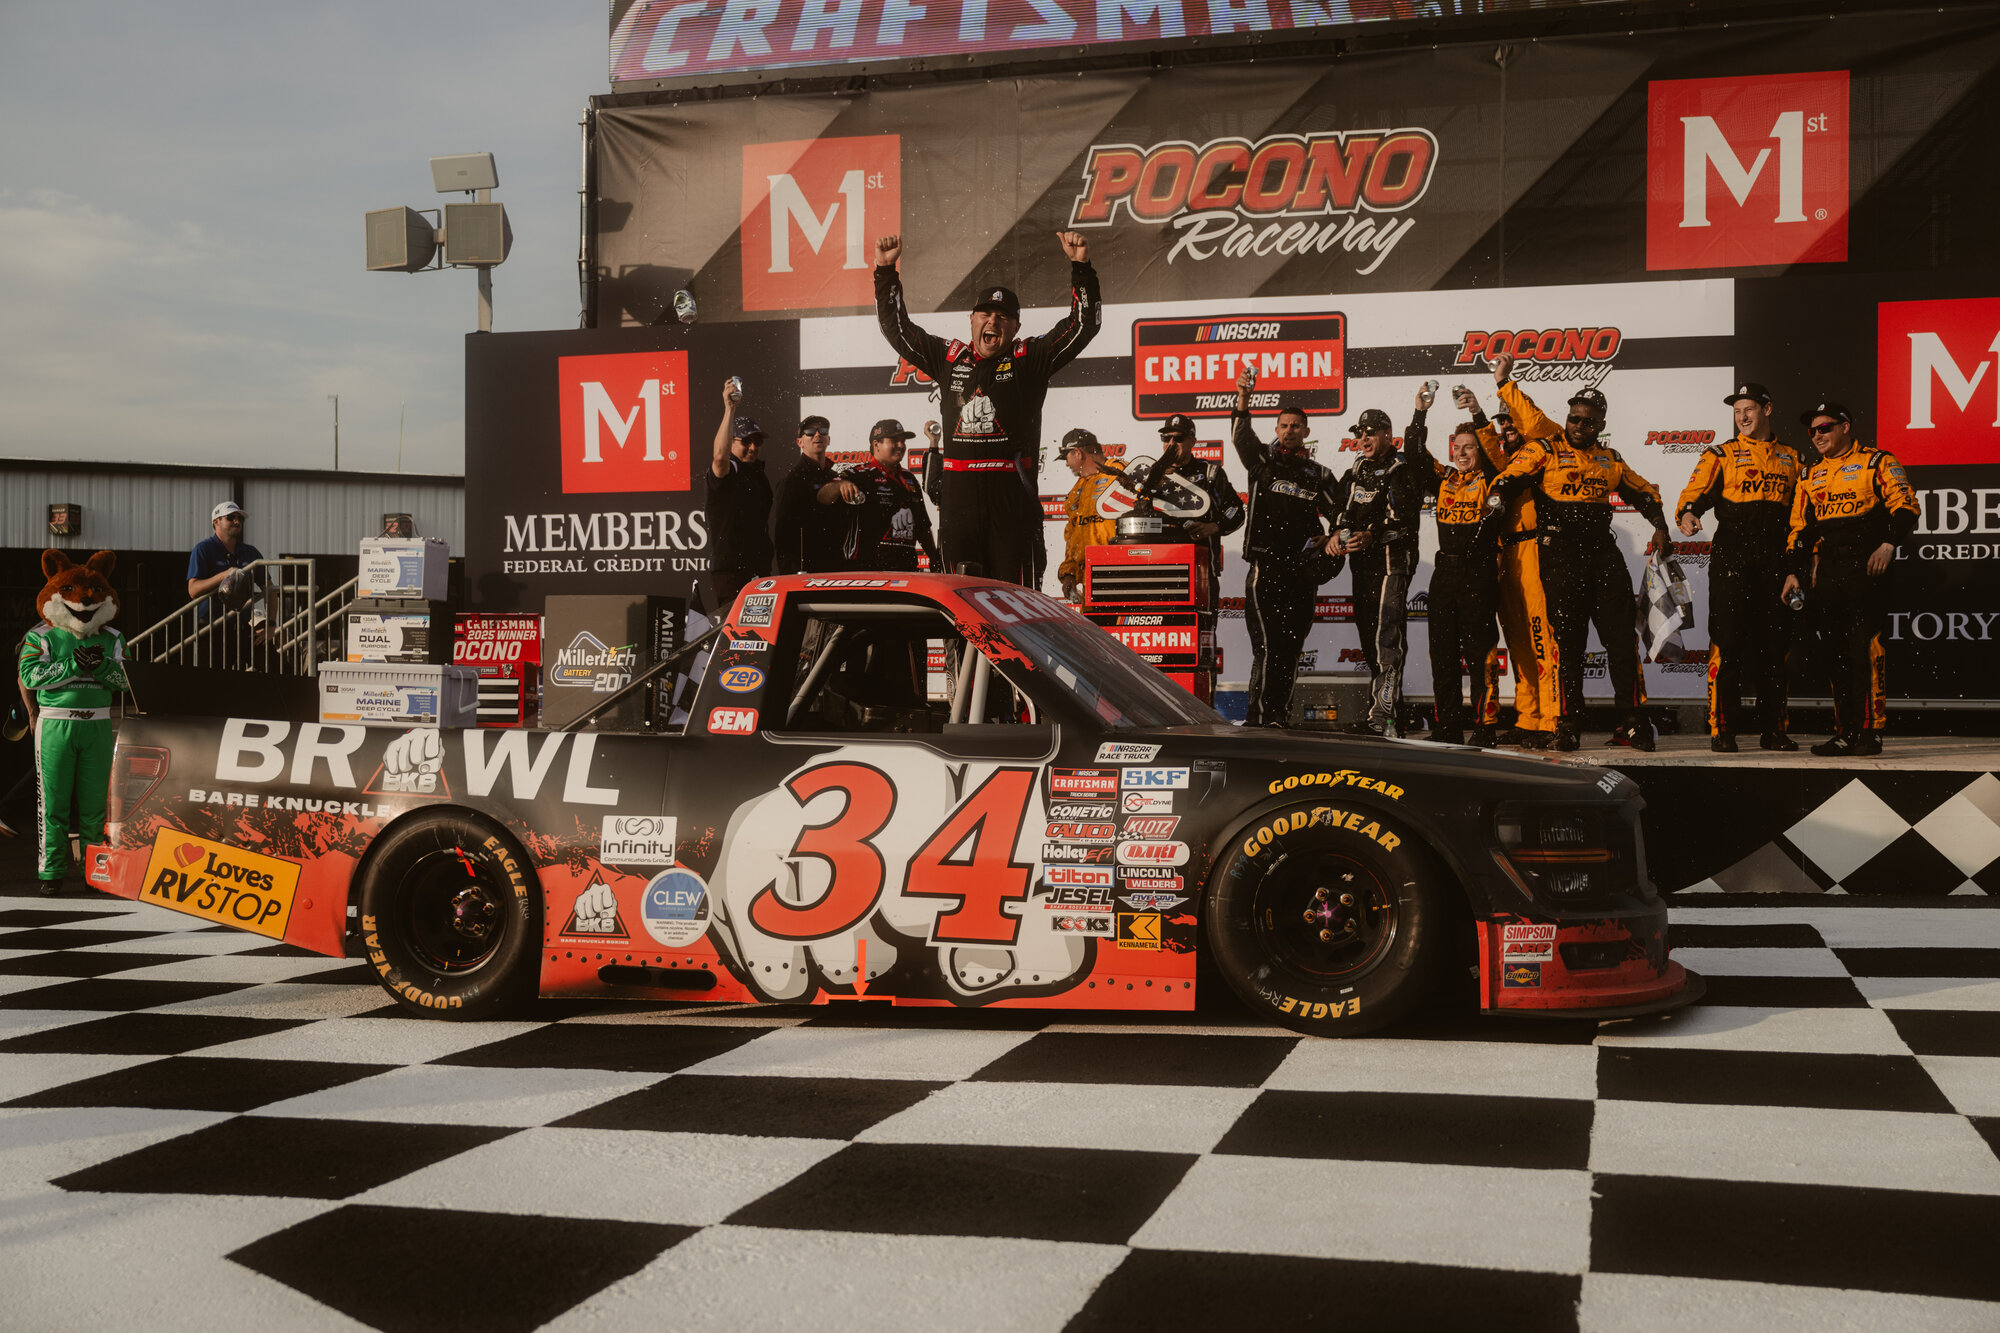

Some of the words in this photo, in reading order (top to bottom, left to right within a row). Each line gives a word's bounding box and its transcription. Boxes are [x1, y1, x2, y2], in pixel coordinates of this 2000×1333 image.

[1069, 127, 1440, 227] POCONO
[1165, 211, 1416, 275] Raceway
[1214, 322, 1281, 341] NASCAR
[1455, 327, 1622, 366] POCONO
[1144, 351, 1333, 382] CRAFTSMAN
[1508, 360, 1614, 387] Raceway
[1195, 394, 1237, 409] TRUCK
[1237, 393, 1280, 408] ERIES
[1645, 430, 1716, 446] POCONO
[503, 510, 709, 553] MEMBERS
[503, 558, 588, 574] FEDERAL
[593, 557, 666, 573] CREDIT
[671, 557, 711, 572] UNI
[803, 579, 889, 590] RIGGS
[746, 597, 774, 607] BUILT
[1314, 605, 1354, 614] RAFTSMA
[742, 615, 769, 624] TOUGH
[1127, 615, 1164, 626] NASCAR
[1888, 612, 1999, 640] TORY
[359, 635, 391, 643] DUAL
[466, 630, 494, 641] 2025
[496, 631, 537, 642] WINNER
[454, 640, 522, 661] OCONO
[730, 641, 756, 649] Mobil
[558, 646, 637, 667] Millertech
[563, 668, 591, 677] BATTERY
[356, 698, 401, 706] MARINE
[710, 711, 755, 732] SEM
[1116, 745, 1153, 753] NASCAR
[1124, 753, 1152, 761] TRUCK
[1054, 778, 1115, 788] CRAFTSMAN
[1124, 771, 1187, 786] SKF
[1268, 769, 1404, 801] GOODYEAR
[189, 789, 259, 808] BARE
[266, 796, 394, 818] KNUCKLE
[1050, 806, 1113, 818] COMETIC
[1045, 823, 1115, 839] CALICO
[1128, 820, 1173, 835] KLOTZ
[1243, 806, 1403, 858] GOODYEAR
[603, 840, 673, 858] Infinity
[747, 760, 1040, 946] 34
[1044, 845, 1088, 862] Holley
[1084, 848, 1112, 863] EFI
[483, 835, 528, 898] EAGLE
[1120, 868, 1172, 879] LINCOLN
[1048, 868, 1111, 885] tilton
[1131, 879, 1177, 889] WELDERS
[653, 890, 702, 906] CLEW
[1044, 888, 1111, 905] JESEL
[1154, 894, 1175, 902] STAR
[576, 917, 615, 932] BKB
[1052, 917, 1109, 931] KOOKS
[1506, 926, 1554, 940] SIMPSON
[1118, 940, 1159, 949] KENNAMETAL
[1505, 943, 1552, 954] ARP
[361, 914, 463, 1010] GOODYEAR
[1278, 996, 1361, 1020] EAGLE
